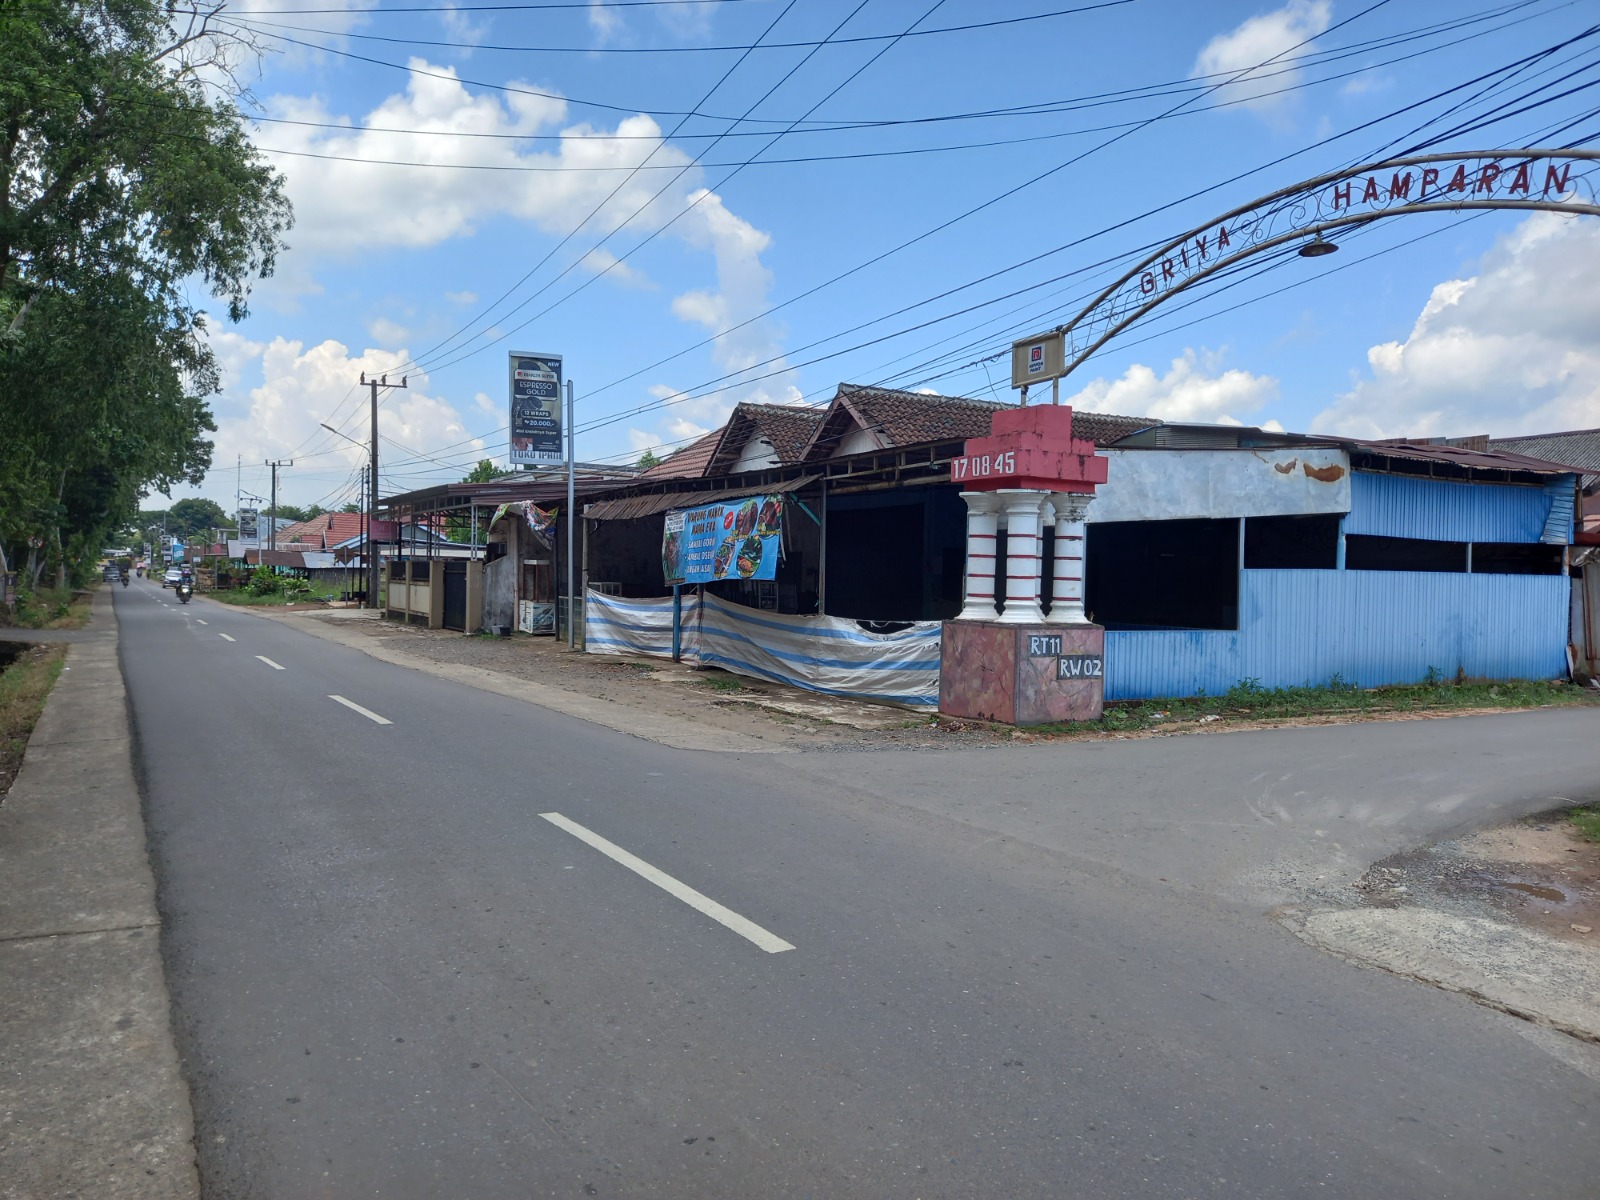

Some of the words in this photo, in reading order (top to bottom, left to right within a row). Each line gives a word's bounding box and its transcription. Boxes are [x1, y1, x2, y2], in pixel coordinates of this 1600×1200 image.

[1139, 226, 1230, 295] GRIYA
[1333, 163, 1570, 210] HAMPARAN
[520, 381, 552, 390] ESPRESSO
